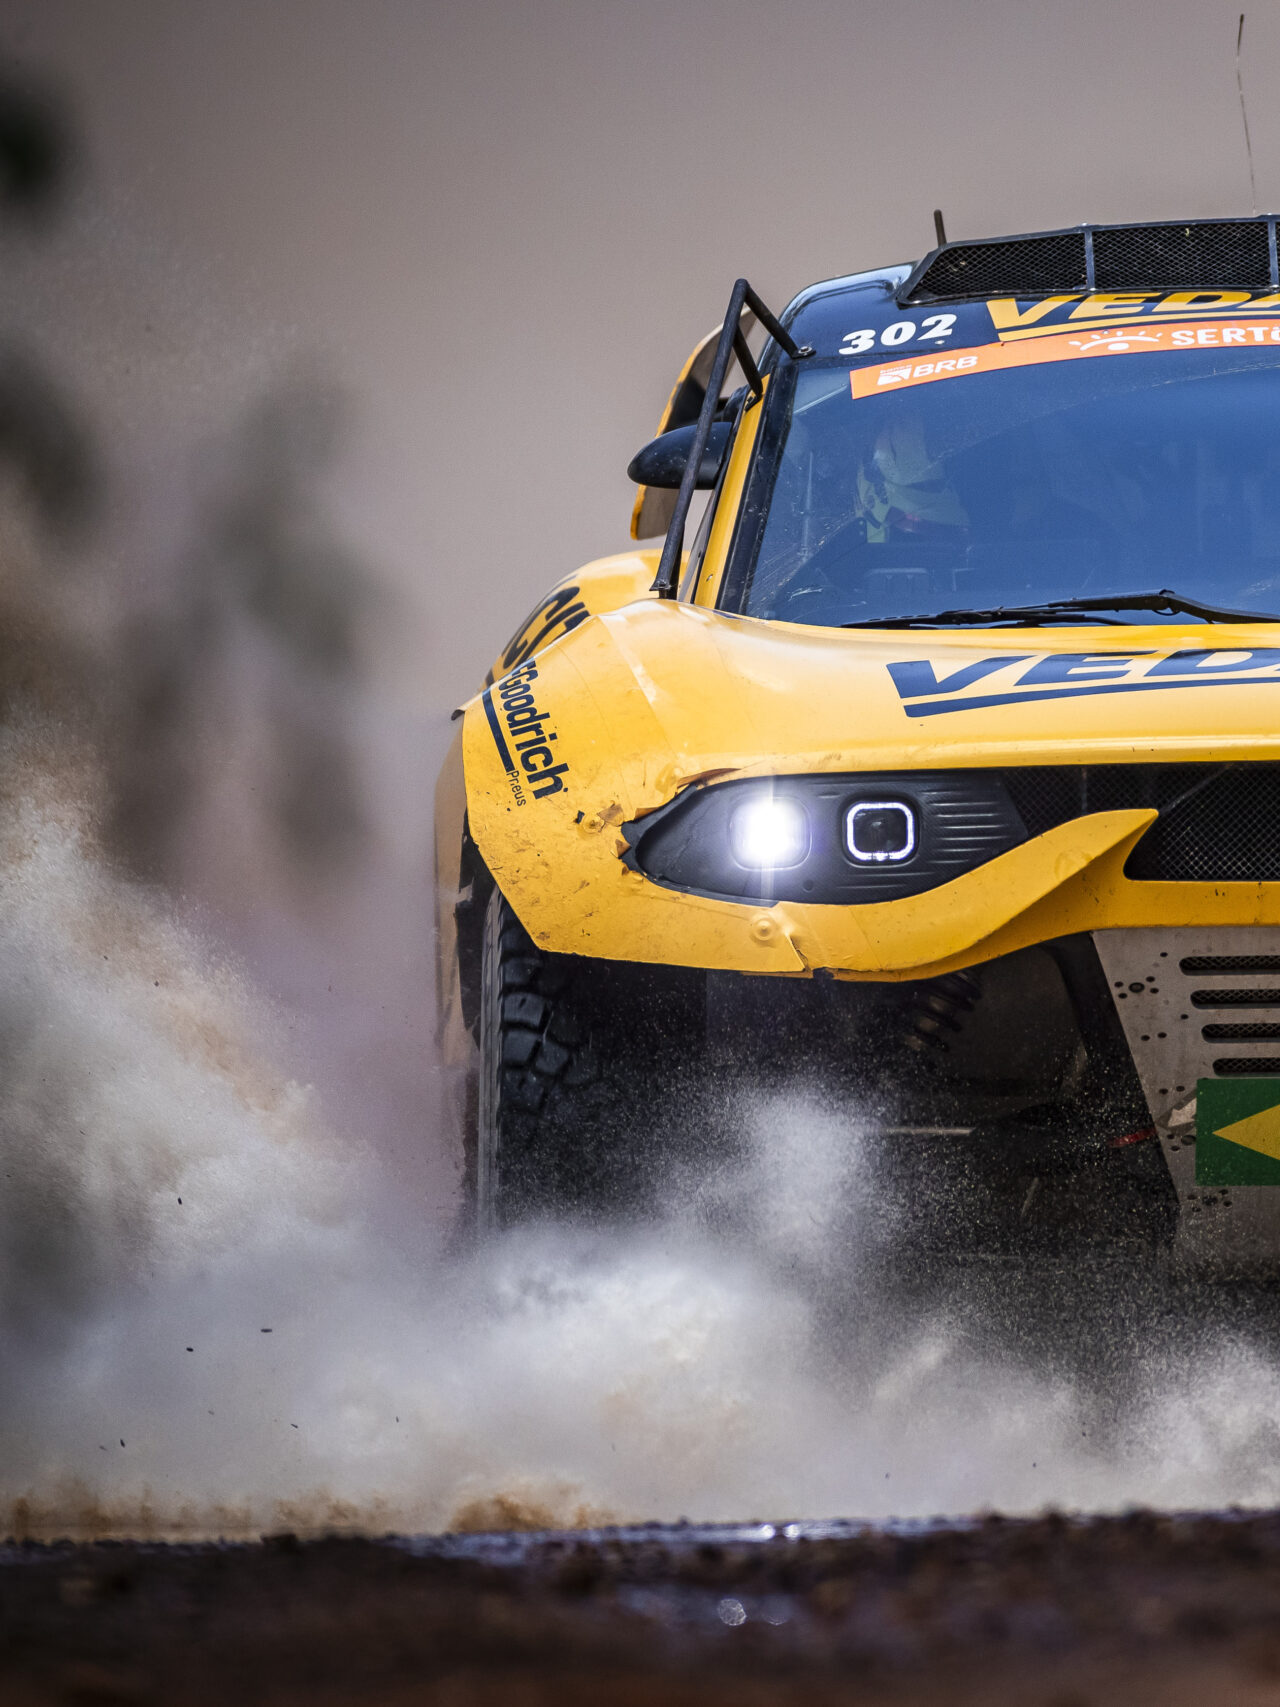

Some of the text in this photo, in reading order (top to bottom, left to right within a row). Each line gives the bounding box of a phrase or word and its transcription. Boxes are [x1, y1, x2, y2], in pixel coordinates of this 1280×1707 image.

[838, 313, 958, 355] 302
[913, 355, 979, 378] BRB
[498, 659, 570, 800] FGoodrich
